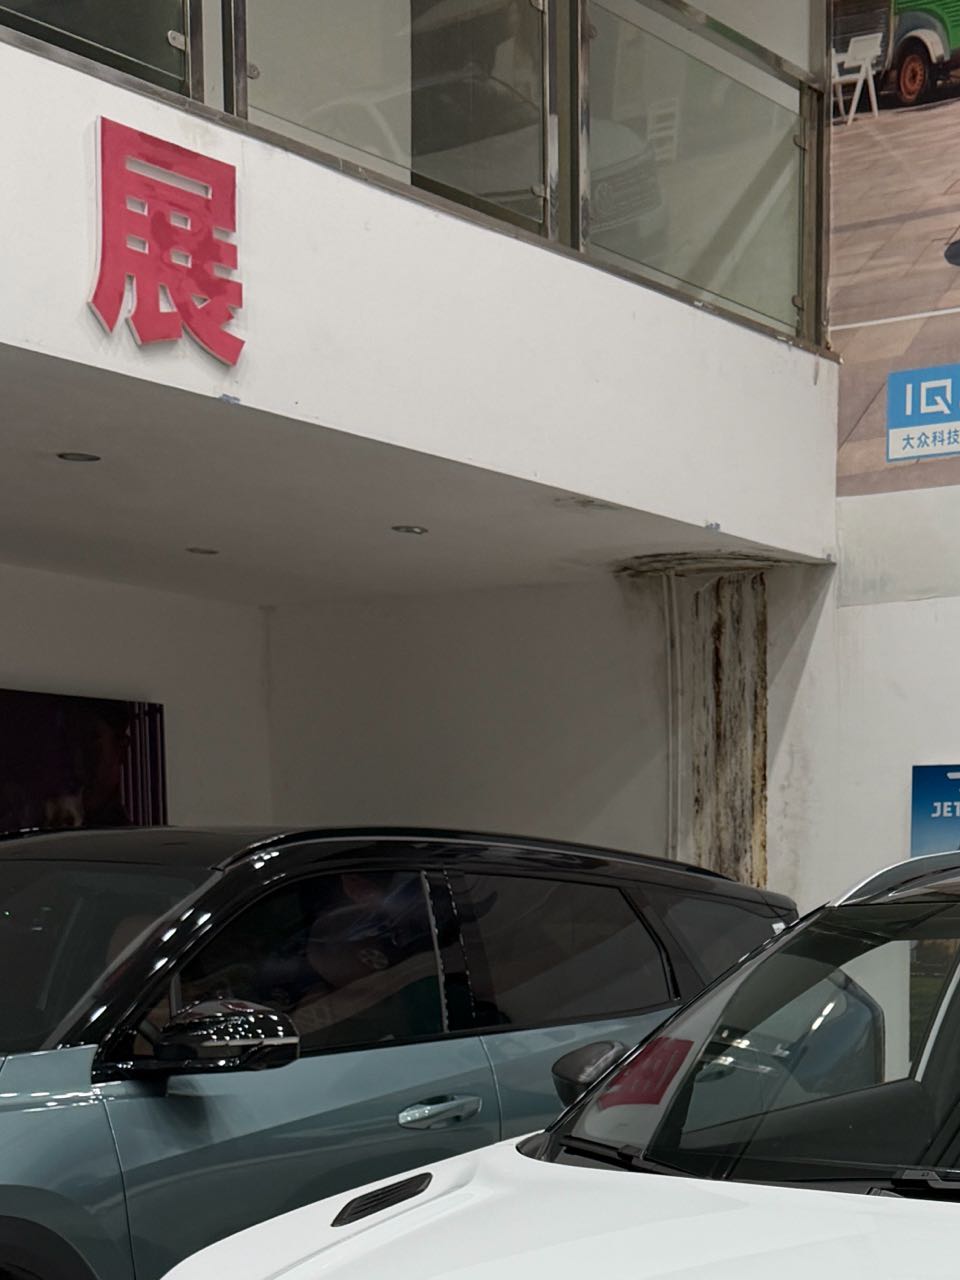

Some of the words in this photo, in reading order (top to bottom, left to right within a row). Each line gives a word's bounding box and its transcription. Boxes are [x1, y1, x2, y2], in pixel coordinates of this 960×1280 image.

[88, 115, 246, 367] 展
[902, 429, 960, 450] 大众科技
